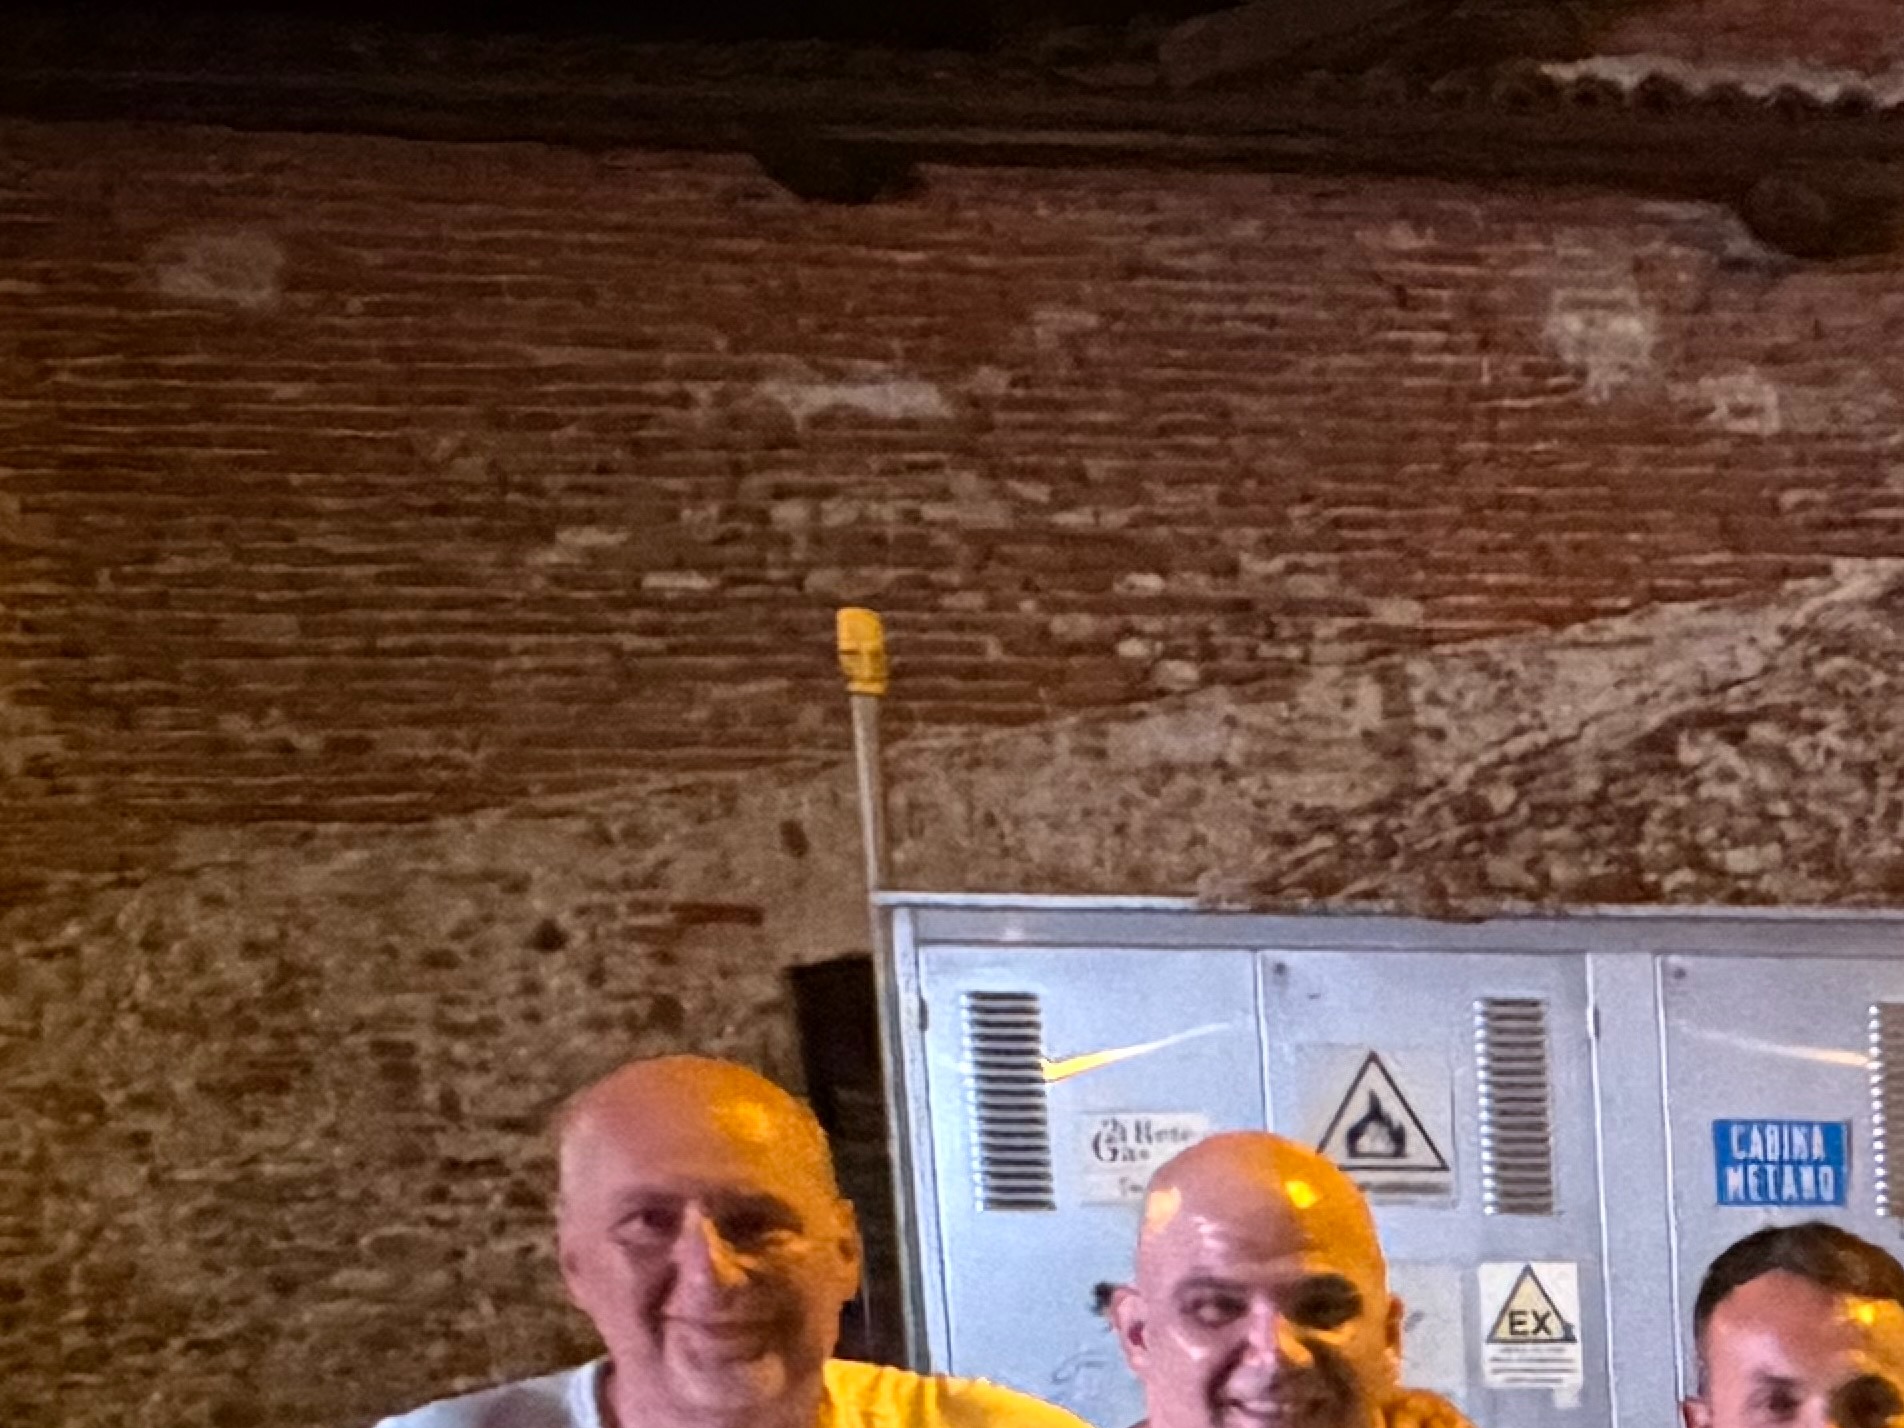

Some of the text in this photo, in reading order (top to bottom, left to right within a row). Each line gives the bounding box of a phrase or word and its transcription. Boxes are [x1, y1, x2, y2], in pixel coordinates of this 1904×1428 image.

[1731, 1124, 1825, 1161] CABINA
[1726, 1164, 1835, 1201] METANO
[1509, 1310, 1552, 1336] EX
